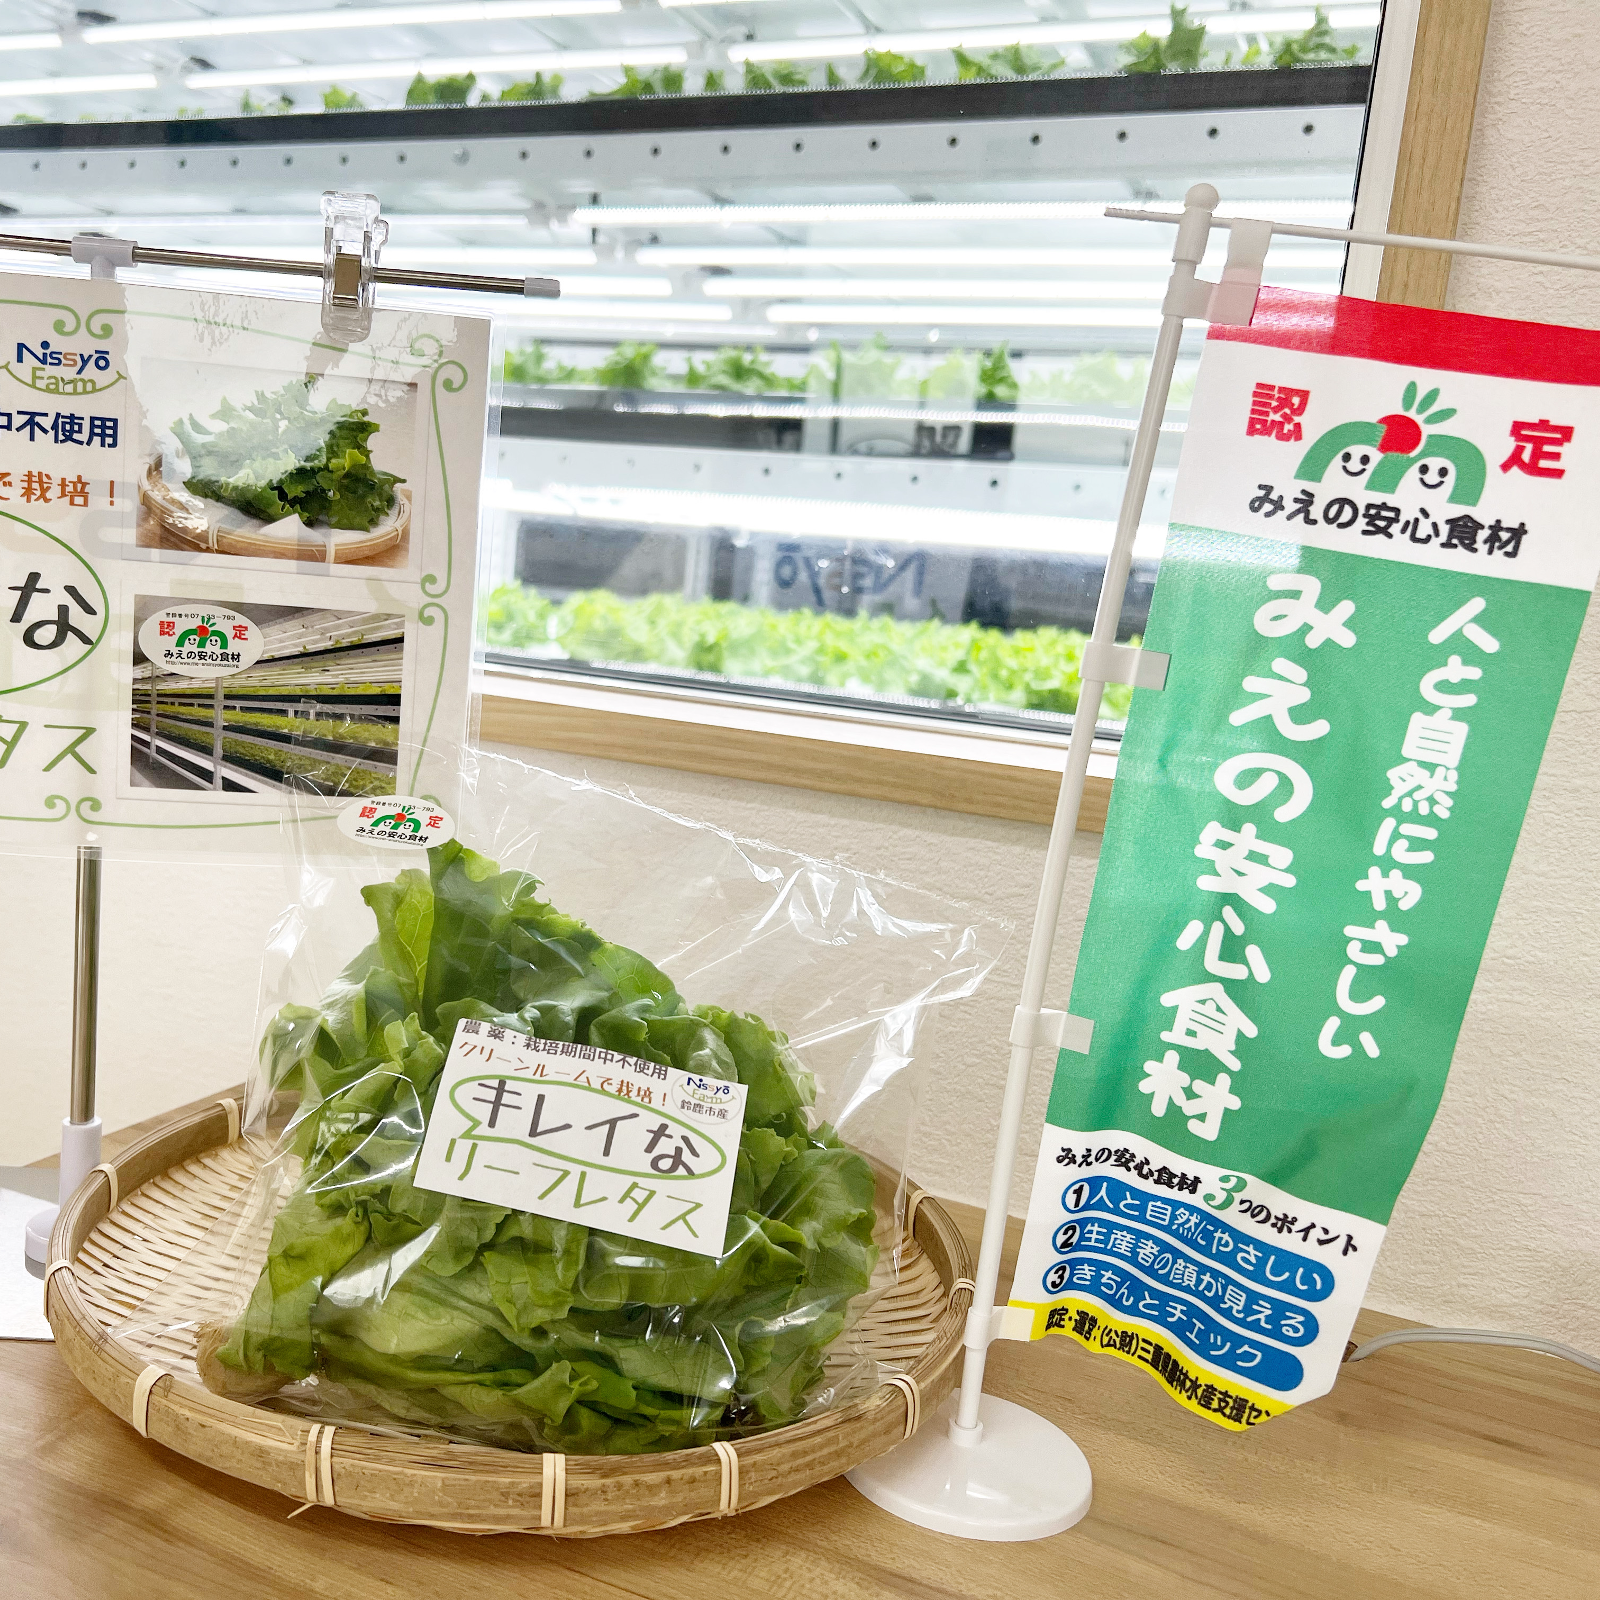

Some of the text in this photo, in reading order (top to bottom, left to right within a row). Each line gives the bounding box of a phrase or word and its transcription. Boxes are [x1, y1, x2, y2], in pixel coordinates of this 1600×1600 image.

[31, 366, 97, 394] Farm
[1246, 383, 1575, 480] 認 定
[1249, 484, 1528, 559] みえの安心食材
[8, 572, 98, 650] な
[163, 649, 241, 663] みえの安心食材
[356, 826, 429, 844] みえの安心食材
[1138, 573, 1358, 1142] みえの安心食材
[1317, 597, 1500, 1059] 人と自然にやさしい
[472, 1079, 700, 1176] キレイな
[680, 1100, 729, 1120] 鈴鹿市産
[445, 1138, 703, 1239] リーフレタス
